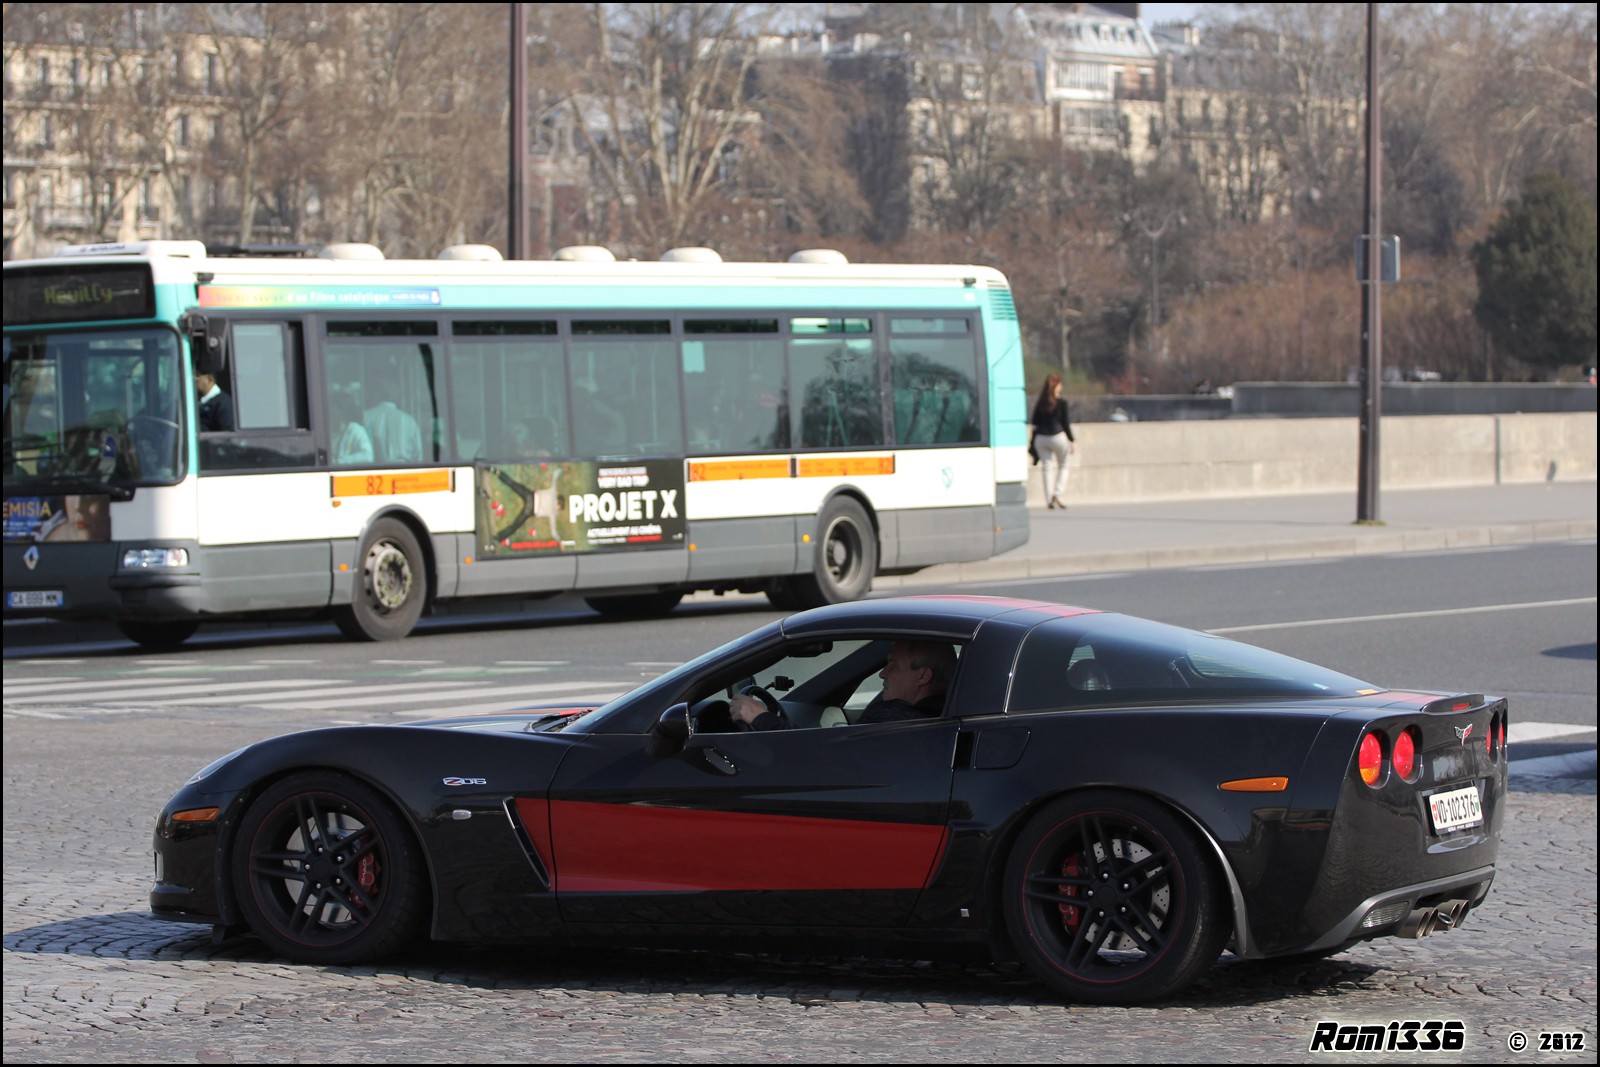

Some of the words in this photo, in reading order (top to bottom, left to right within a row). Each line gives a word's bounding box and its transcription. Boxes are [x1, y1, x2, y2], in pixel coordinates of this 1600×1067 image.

[366, 475, 383, 495] 82
[568, 490, 658, 524] PROJET
[660, 489, 679, 519] X
